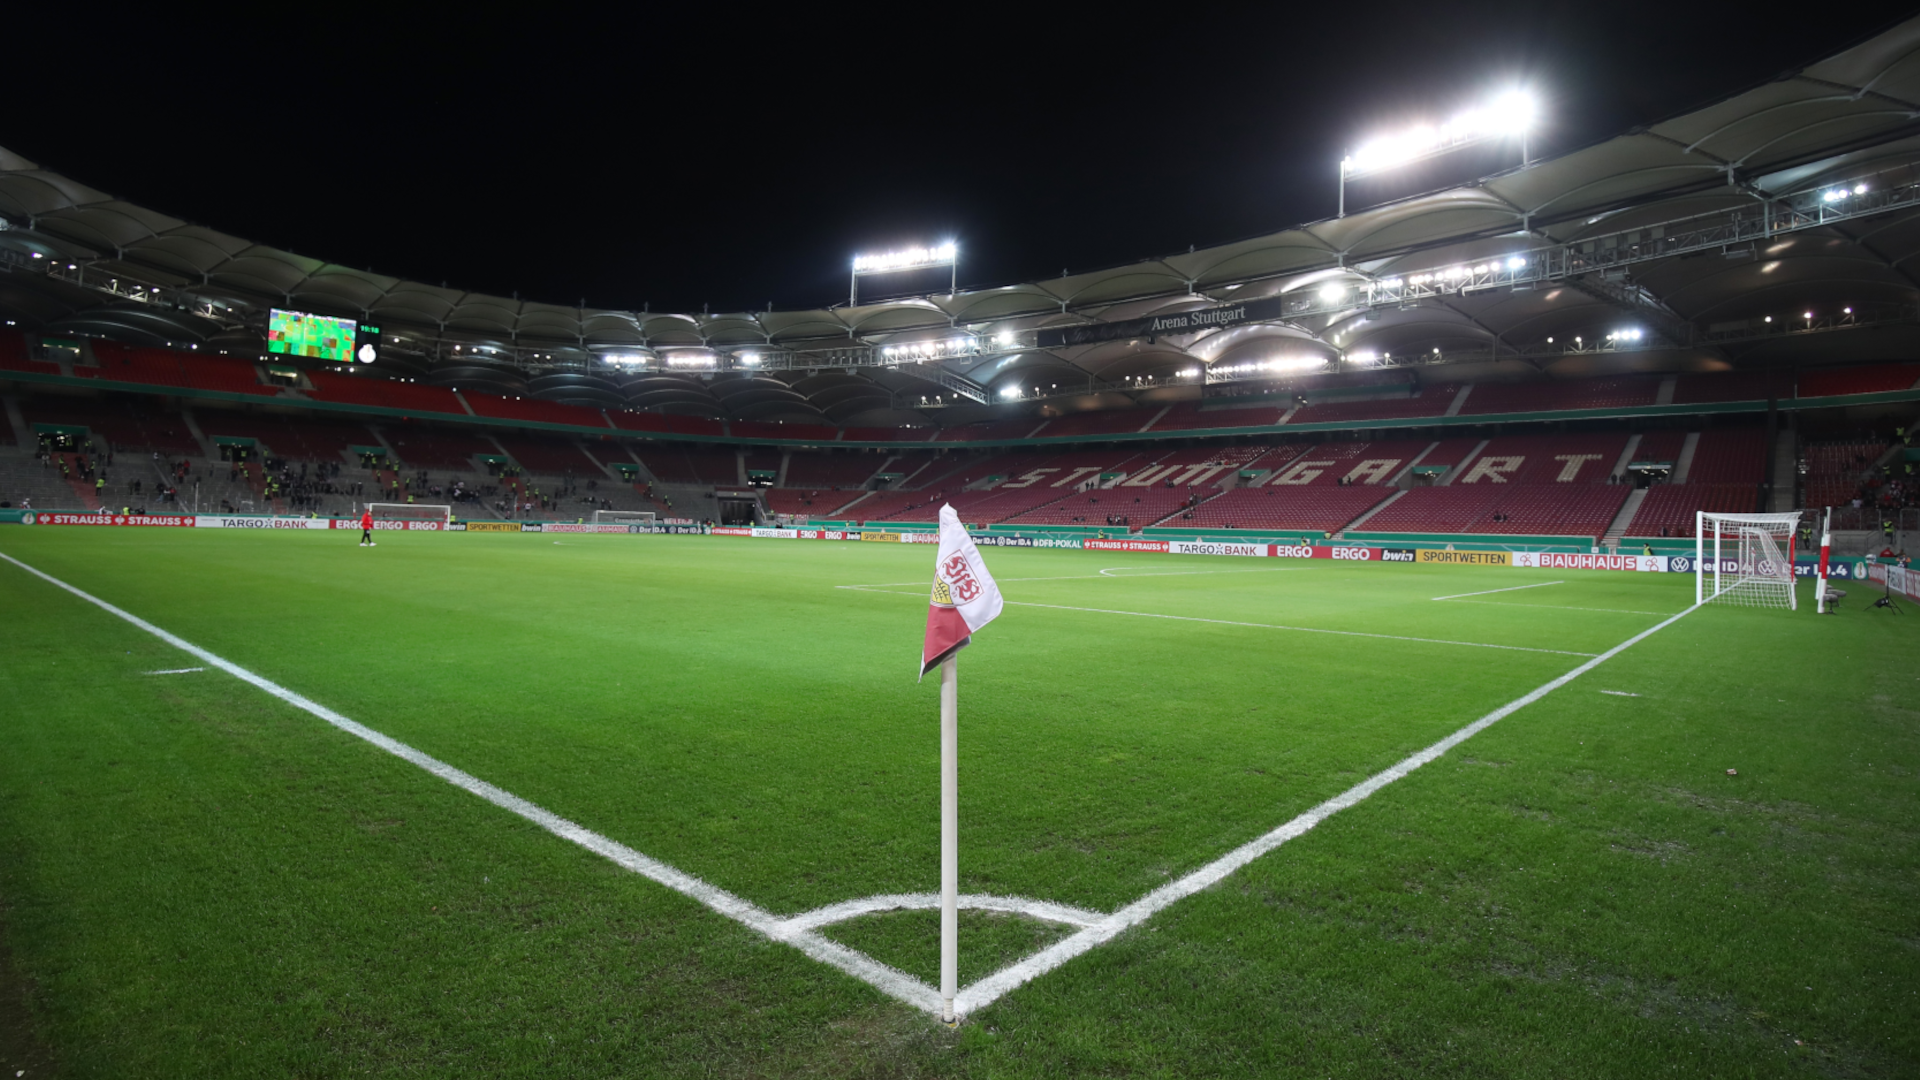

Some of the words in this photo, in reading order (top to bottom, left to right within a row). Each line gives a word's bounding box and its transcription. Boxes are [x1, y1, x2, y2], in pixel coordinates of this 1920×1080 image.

[1152, 317, 1188, 330] Arena
[1191, 306, 1246, 325] Stuttgart
[54, 514, 112, 525] STRAUSS
[128, 516, 181, 526] STRAUSS
[373, 520, 404, 530] ERGO
[408, 521, 438, 531] ERGO
[469, 522, 519, 531] SPORTWETTEN
[521, 523, 542, 532] bwin
[801, 530, 817, 539] ERGO
[825, 531, 842, 540] ERGO
[864, 533, 899, 541] SPORTWETTEN
[912, 534, 939, 543] BAUHA
[1006, 537, 1017, 546] Der
[1018, 538, 1031, 547] ID.4
[1039, 539, 1082, 549] DFB-POKAL
[1091, 540, 1121, 549] STRAUSS
[1129, 542, 1162, 550] STRAUSS
[1277, 545, 1313, 558] ERGO
[1332, 548, 1370, 560] ERGO
[1382, 549, 1414, 561] bwin
[1423, 551, 1506, 565] SPORTWETTEN
[1541, 554, 1636, 570] BAUHAUS
